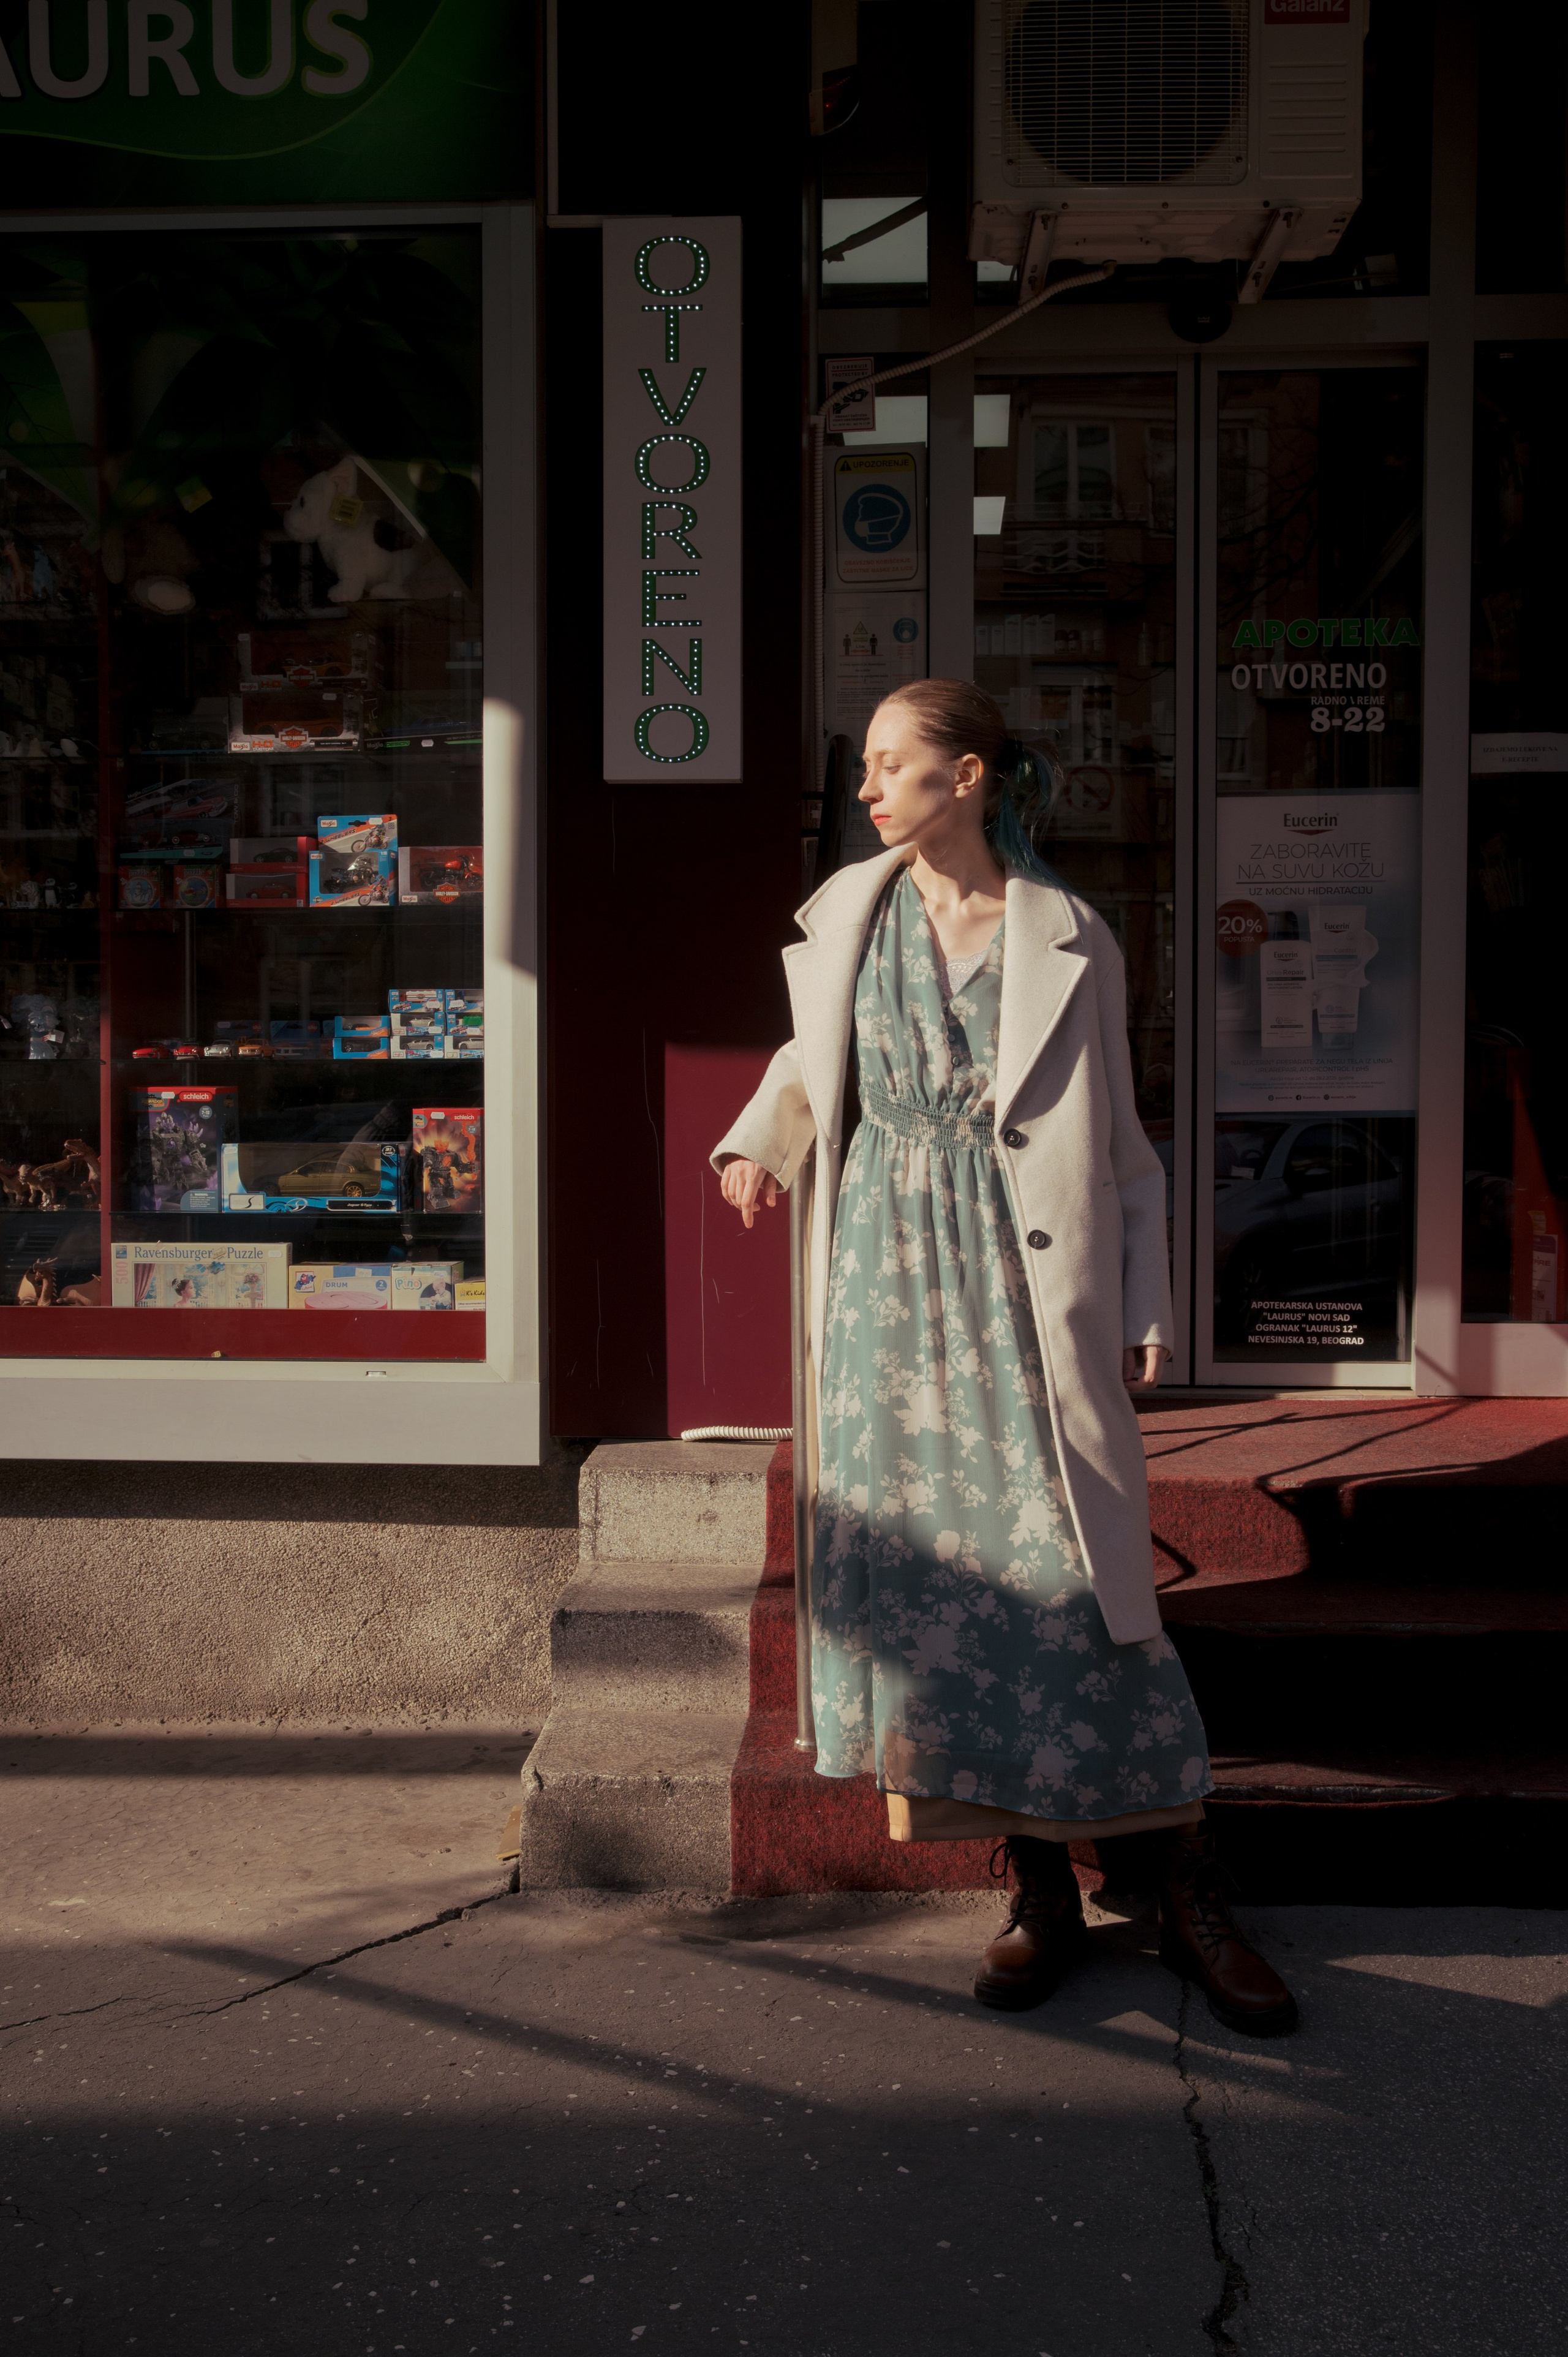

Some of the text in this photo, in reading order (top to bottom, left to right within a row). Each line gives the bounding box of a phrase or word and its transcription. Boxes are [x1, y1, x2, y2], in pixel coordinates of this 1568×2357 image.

[1270, 0, 1344, 12] Galanz
[0, 0, 369, 99] URUS
[853, 459, 910, 469] UPOZORENJE
[634, 235, 711, 764] OTVORENO
[1231, 617, 1420, 649] APOTEKA
[1231, 662, 1387, 690] OTVORENO
[1311, 695, 1347, 705] RADNO
[1310, 707, 1385, 733] 8-22
[1283, 812, 1340, 828] Eucerin
[326, 828, 356, 843] WHEELERS
[1250, 843, 1372, 859] ZABORAVITE
[1238, 859, 1384, 880] NA SUVU KOŽU
[336, 892, 361, 904] WHEELERS
[1249, 886, 1373, 896] UZ MOĆNU HIDRATACIJU
[1217, 916, 1263, 935] 20%
[134, 1246, 213, 1261] Ravensburger
[226, 1246, 263, 1259] Puzzle
[115, 1261, 129, 1285] 500
[396, 1278, 421, 1289] Pino
[1251, 1301, 1363, 1311] APOTEKARSKA USTANOVA
[1262, 1312, 1351, 1322] "LAURUS" NOVI SAD
[1255, 1323, 1358, 1333] OGRANAK "LAURUS 12"
[1248, 1335, 1365, 1346] NEVESINJSKA 19, BEOGRAD
